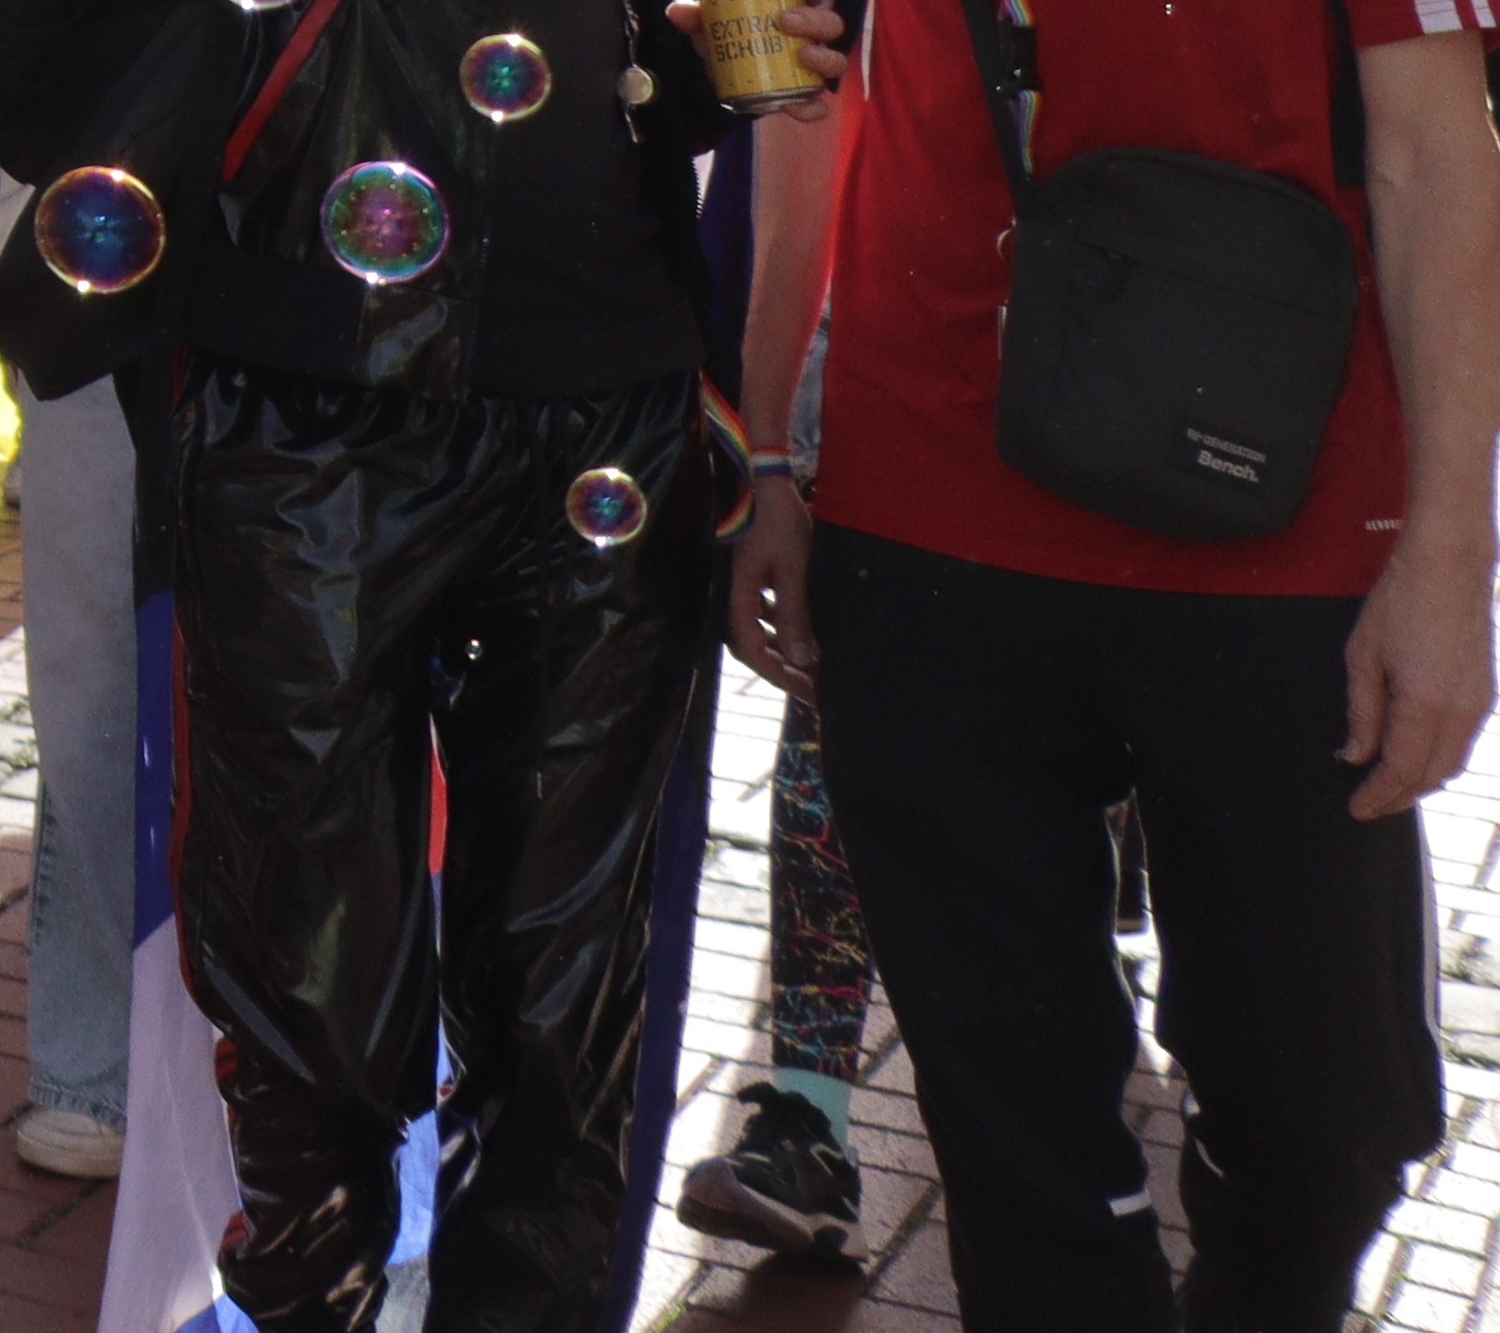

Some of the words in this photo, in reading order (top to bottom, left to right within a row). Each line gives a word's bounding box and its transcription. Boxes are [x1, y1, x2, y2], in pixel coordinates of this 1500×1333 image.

[711, 14, 781, 40] EXTRA
[716, 33, 783, 62] SCHUB
[1198, 450, 1259, 482] Bench.
